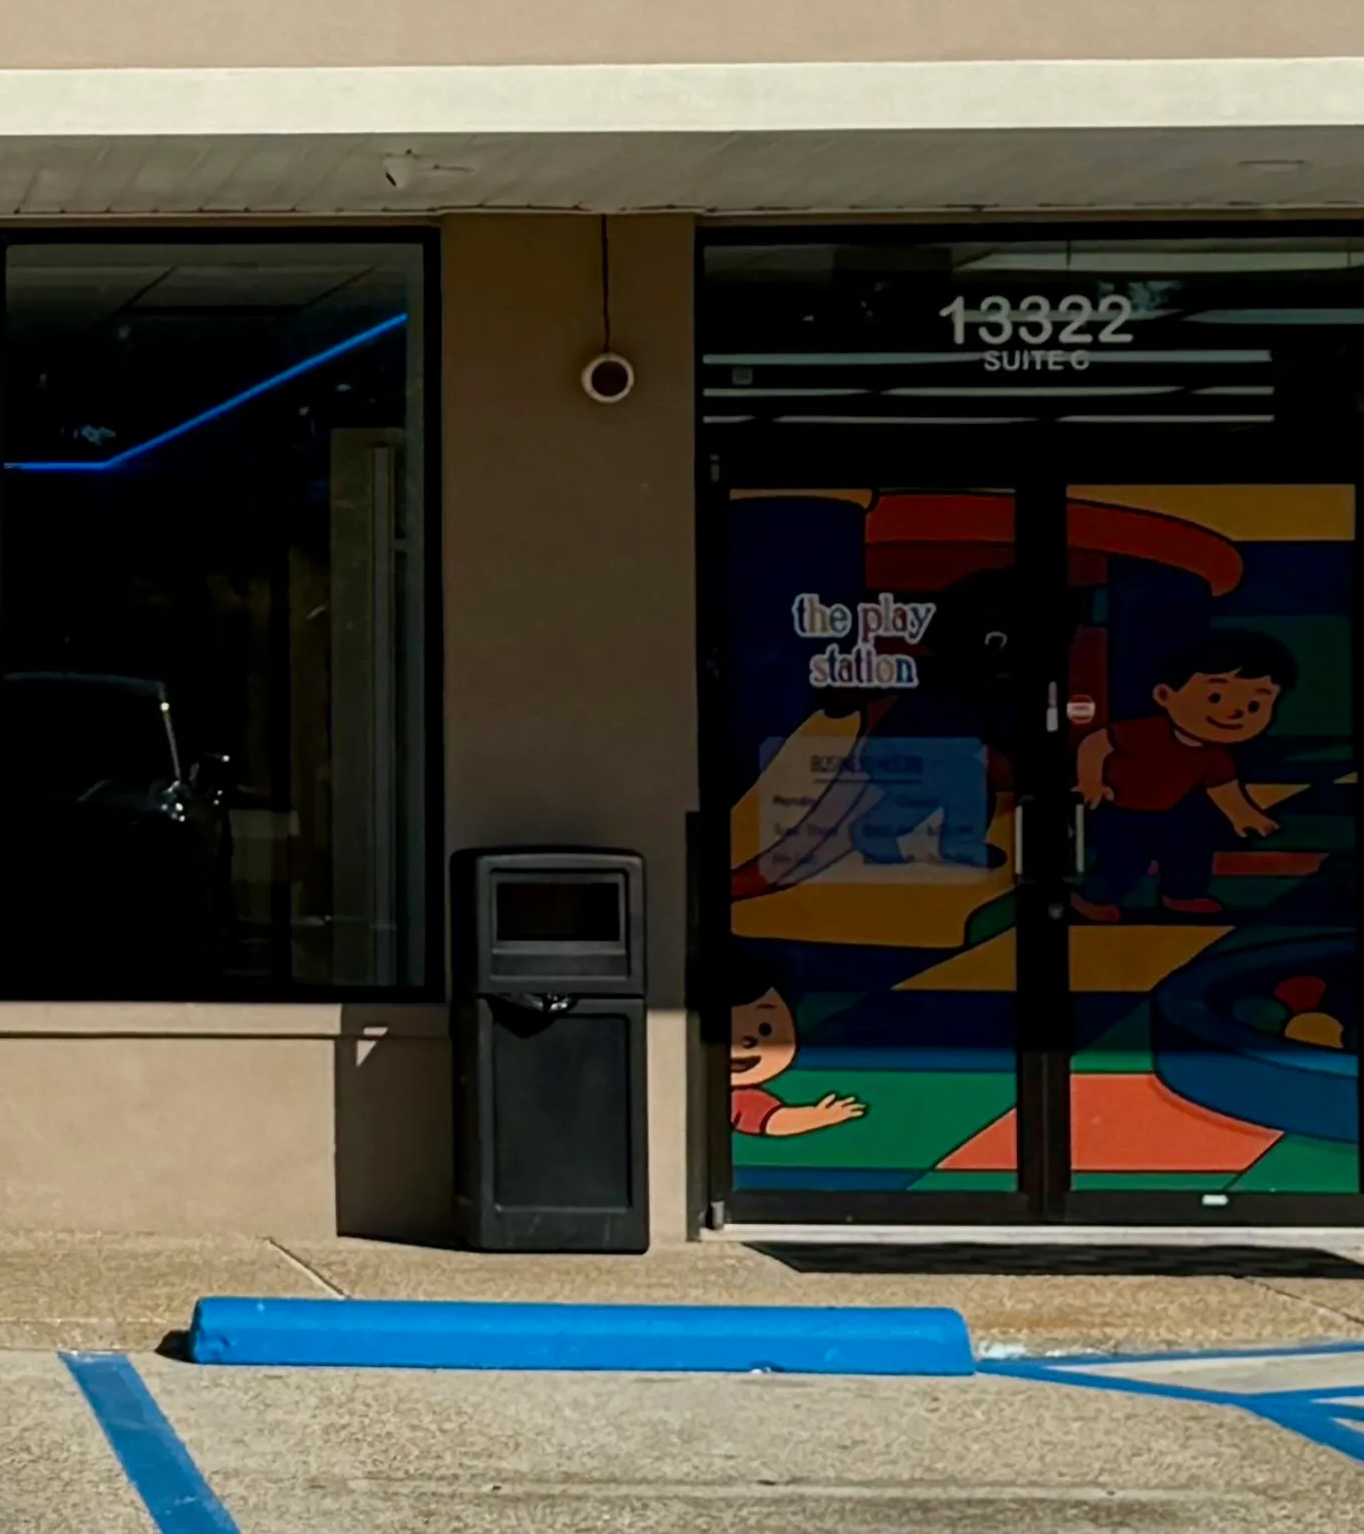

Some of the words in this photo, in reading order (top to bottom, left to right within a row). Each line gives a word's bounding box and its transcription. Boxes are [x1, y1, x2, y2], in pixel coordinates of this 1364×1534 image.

[939, 294, 1134, 345] 13322
[984, 350, 1065, 371] SUITE
[792, 593, 852, 638] the
[857, 592, 936, 645] play
[809, 643, 919, 688] station
